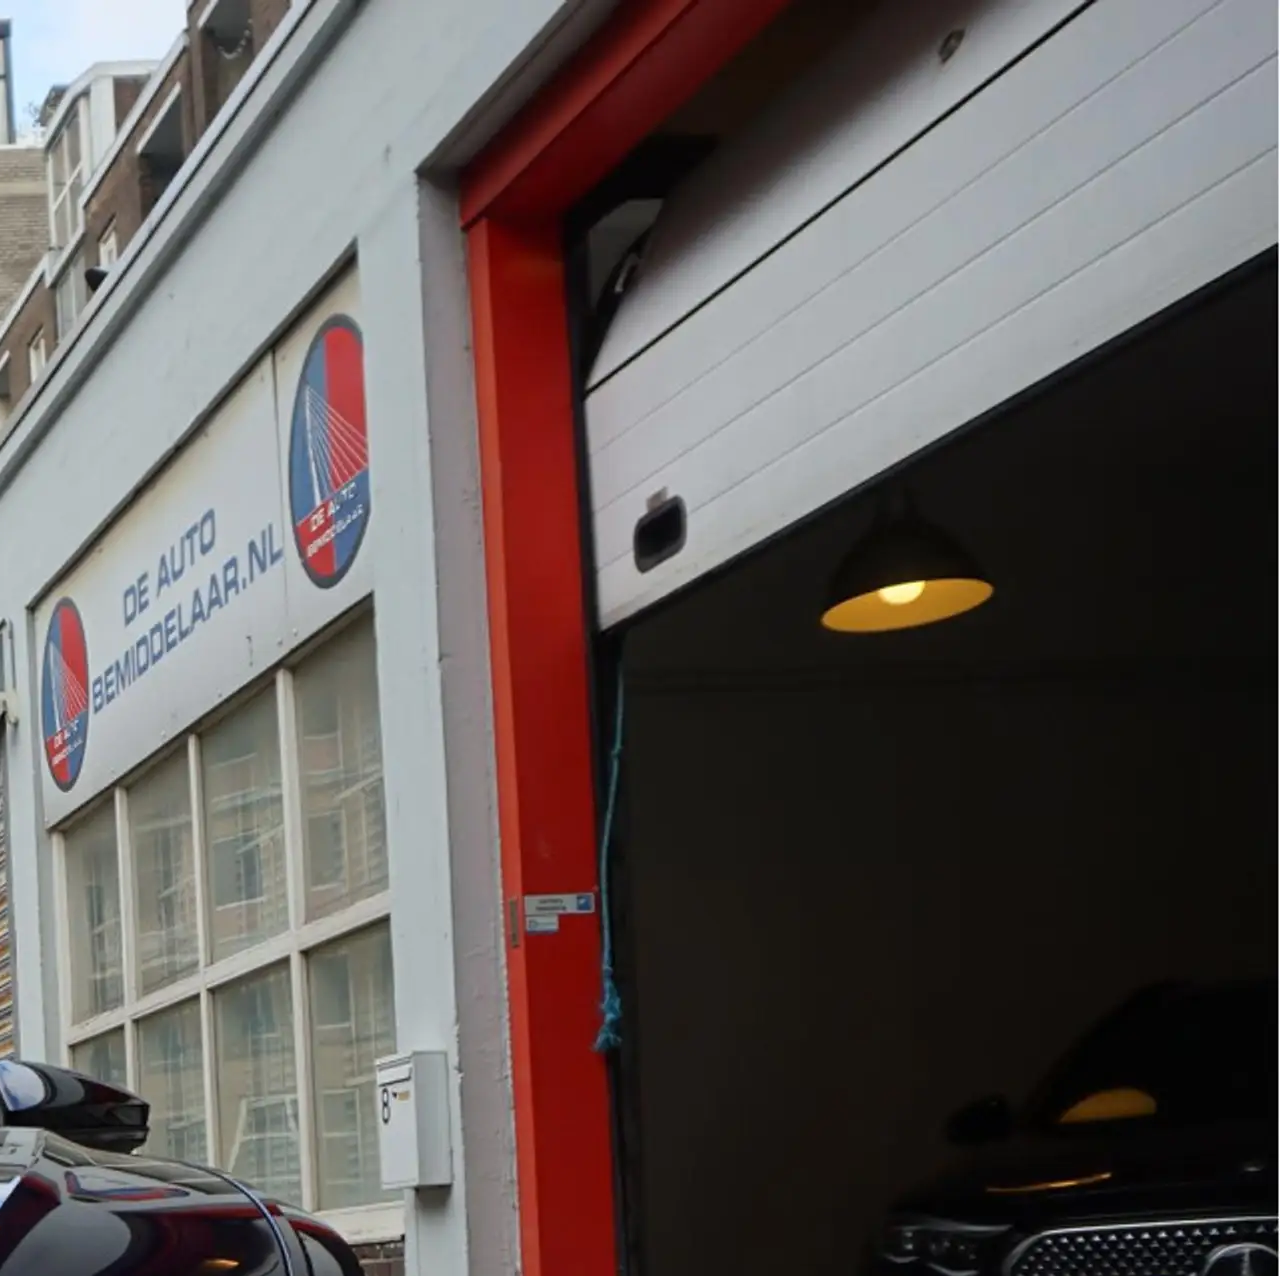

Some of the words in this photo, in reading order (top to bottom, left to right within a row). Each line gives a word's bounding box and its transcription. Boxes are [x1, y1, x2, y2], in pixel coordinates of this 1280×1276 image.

[92, 521, 285, 715] BEMIDDELAAR.NL
[122, 570, 150, 628] DE
[156, 508, 217, 599] AUTO
